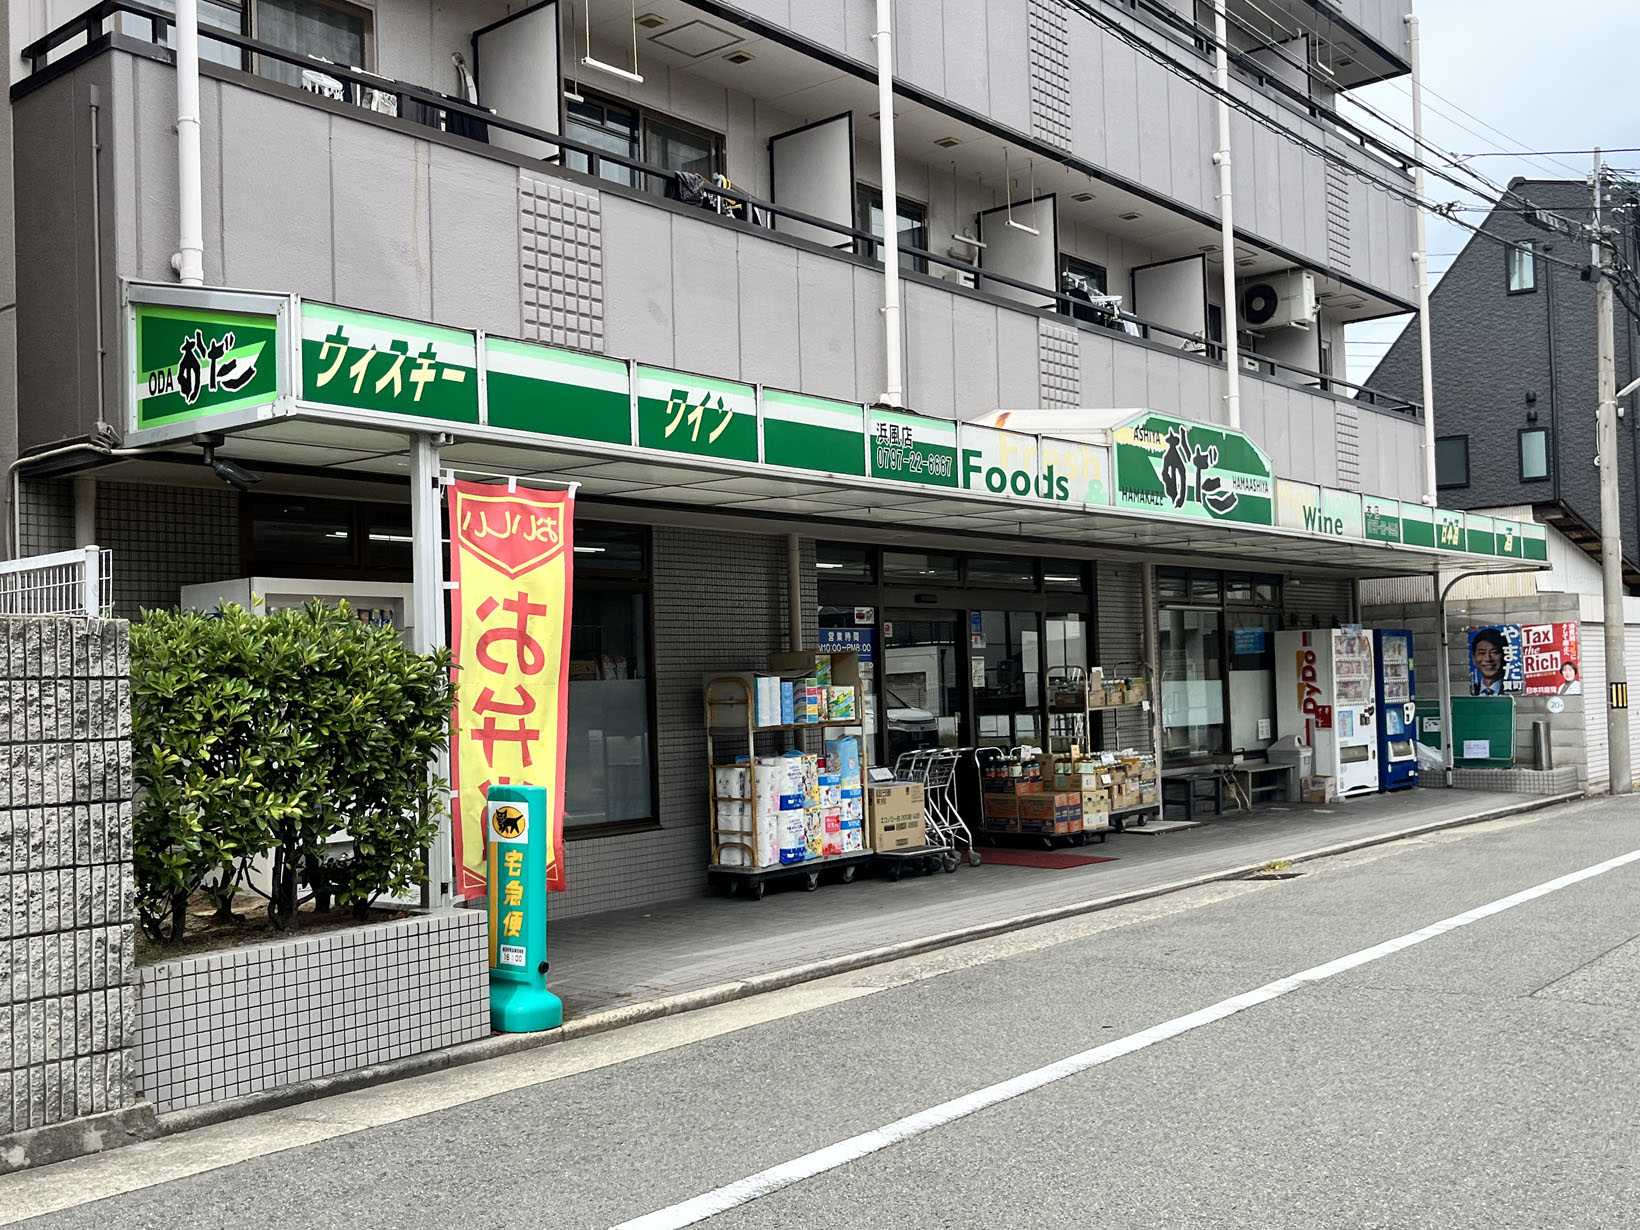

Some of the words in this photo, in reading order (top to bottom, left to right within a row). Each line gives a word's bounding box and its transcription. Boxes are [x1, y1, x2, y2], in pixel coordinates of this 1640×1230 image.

[148, 368, 174, 396] ODA
[664, 388, 733, 444] ワイン
[875, 422, 914, 449] 浜風店
[1133, 427, 1162, 445] ASHIYA
[876, 446, 953, 478] 0797-22-6667
[963, 448, 1070, 502] Foods
[1232, 475, 1269, 493] HAMAASHIYA
[1303, 505, 1344, 536] Wine
[1523, 629, 1551, 645] Tax
[1524, 646, 1540, 655] the
[1500, 626, 1522, 680] やまだ
[1525, 654, 1558, 673] Rich
[502, 849, 525, 938] 宅急便
